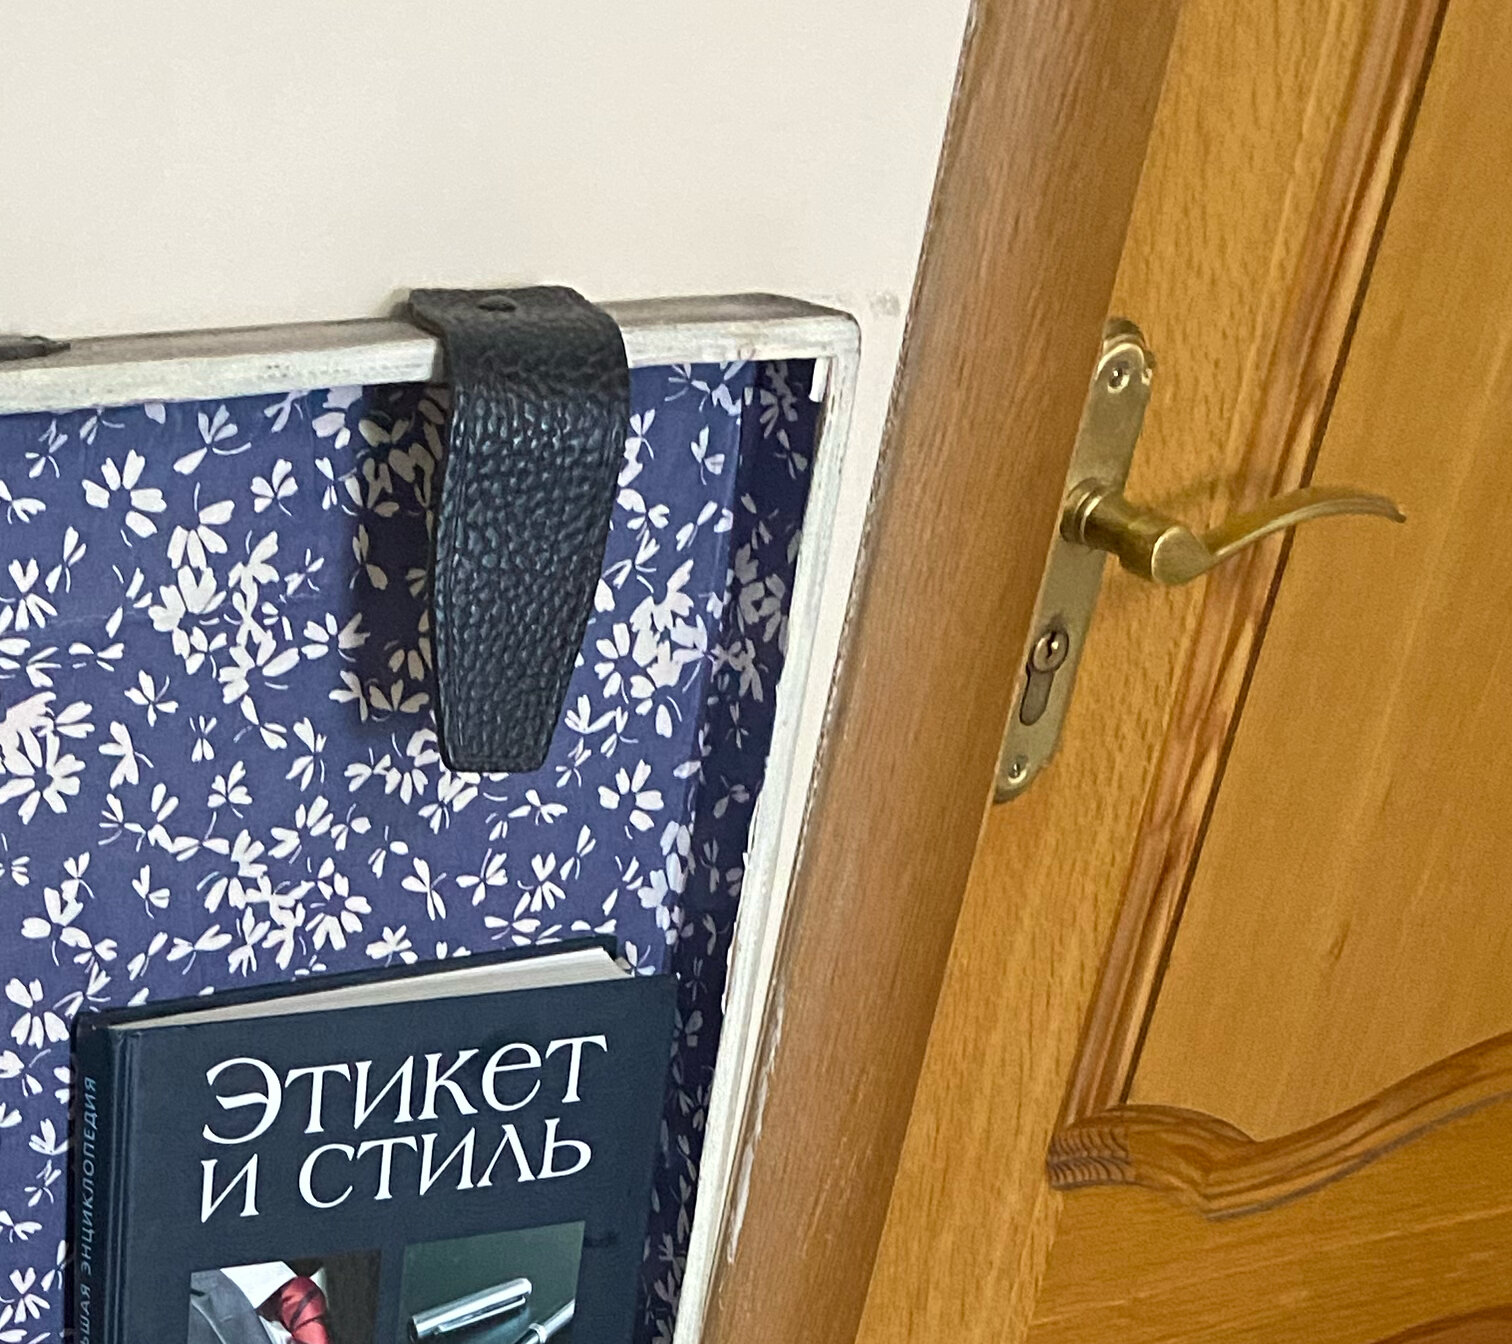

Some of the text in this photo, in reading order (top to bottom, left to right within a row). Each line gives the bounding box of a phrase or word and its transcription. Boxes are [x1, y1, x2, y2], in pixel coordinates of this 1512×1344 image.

[201, 1033, 608, 1146] ЭТИКЕТ
[79, 1076, 98, 1276] ЭНЦИКЛОПЕДИЯ
[199, 1118, 593, 1224] И СТИЛЬ
